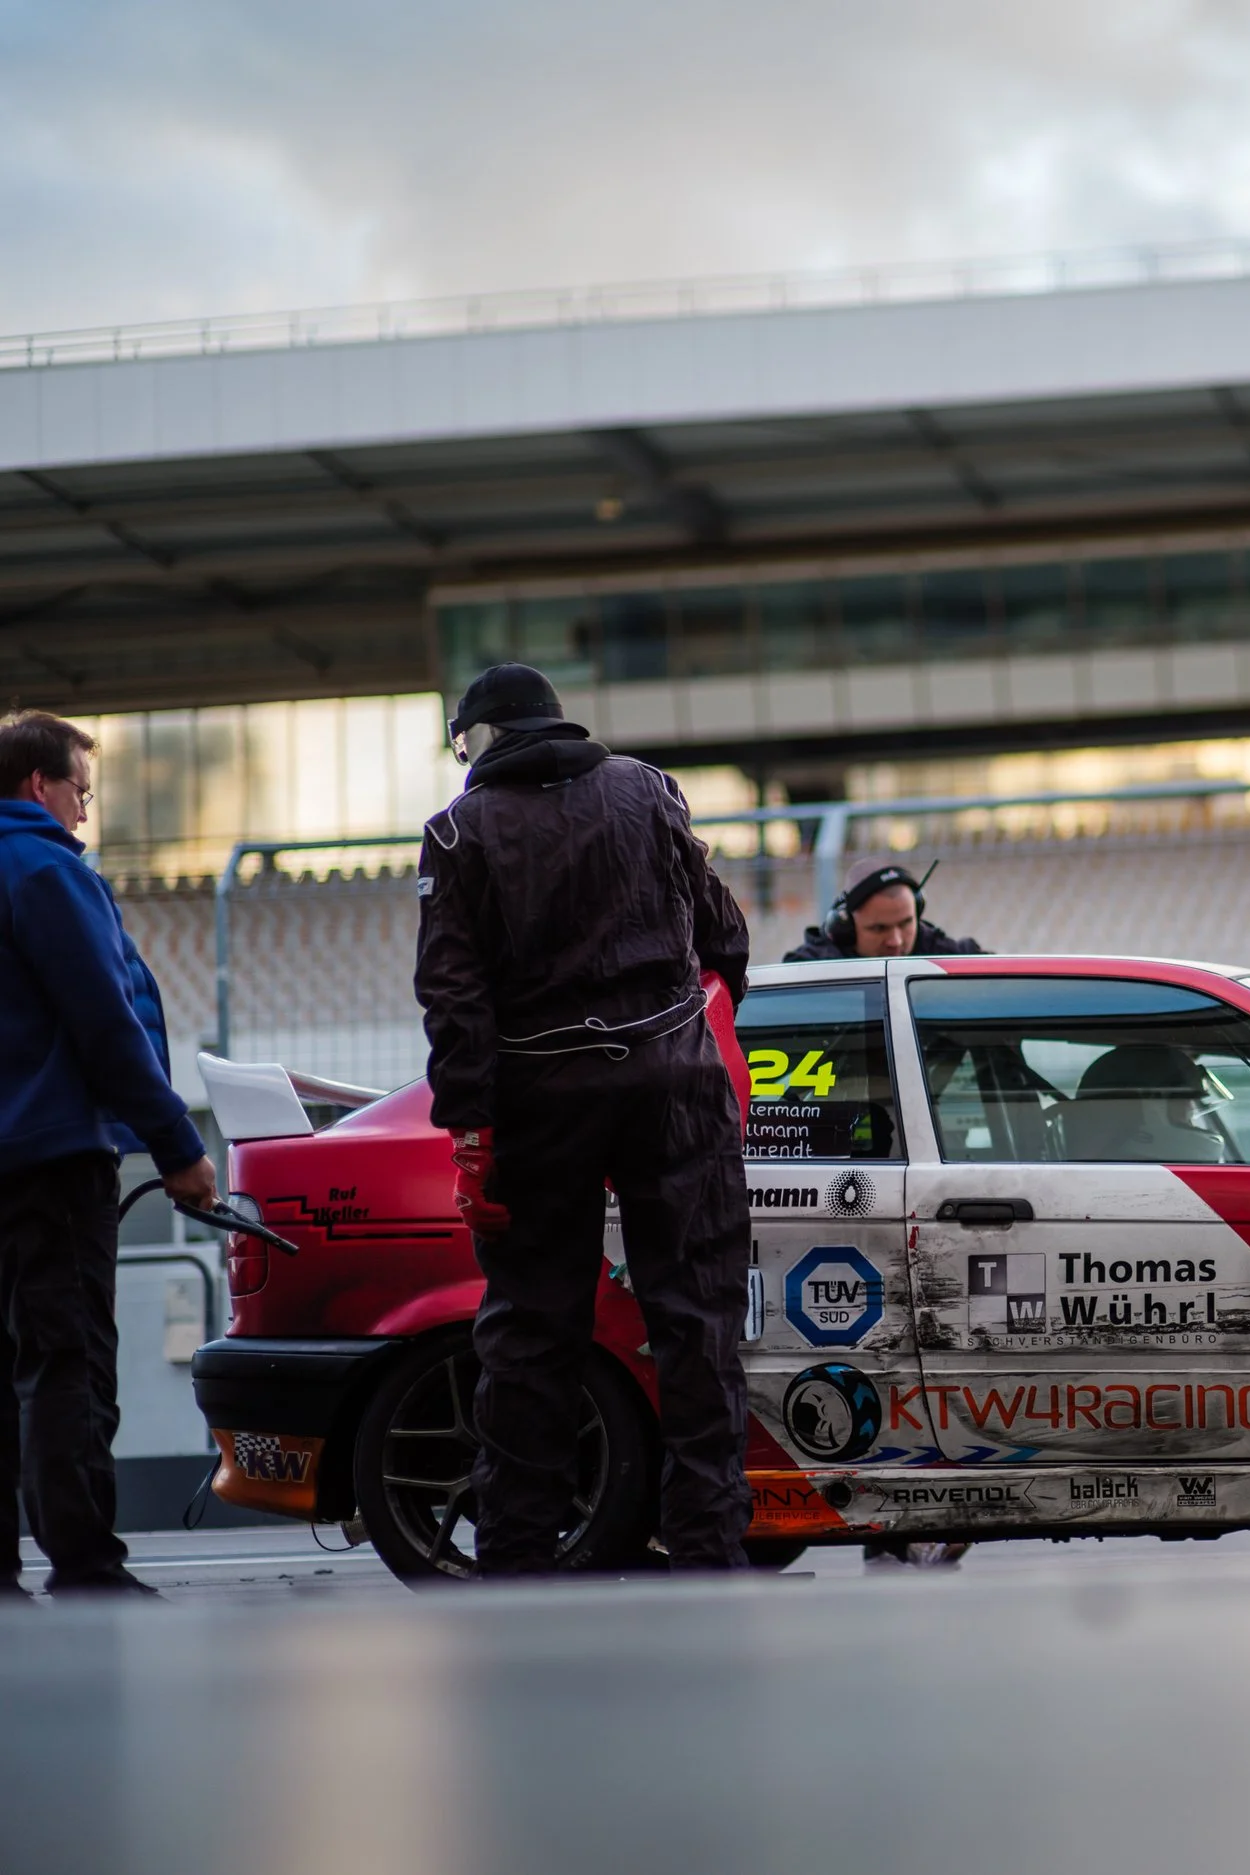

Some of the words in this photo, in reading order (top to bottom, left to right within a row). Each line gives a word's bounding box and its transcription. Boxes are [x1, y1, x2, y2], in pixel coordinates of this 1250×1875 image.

[320, 1206, 369, 1221] Keller
[978, 1262, 997, 1288] T
[1059, 1252, 1217, 1284] Thomas
[808, 1281, 861, 1304] TÜV
[819, 1310, 850, 1324] SÜD
[1009, 1301, 1044, 1324] W
[1060, 1292, 1216, 1326] Wührl
[245, 1449, 313, 1483] KW
[893, 1486, 1020, 1504] RAVENOL
[1071, 1474, 1139, 1500] balack
